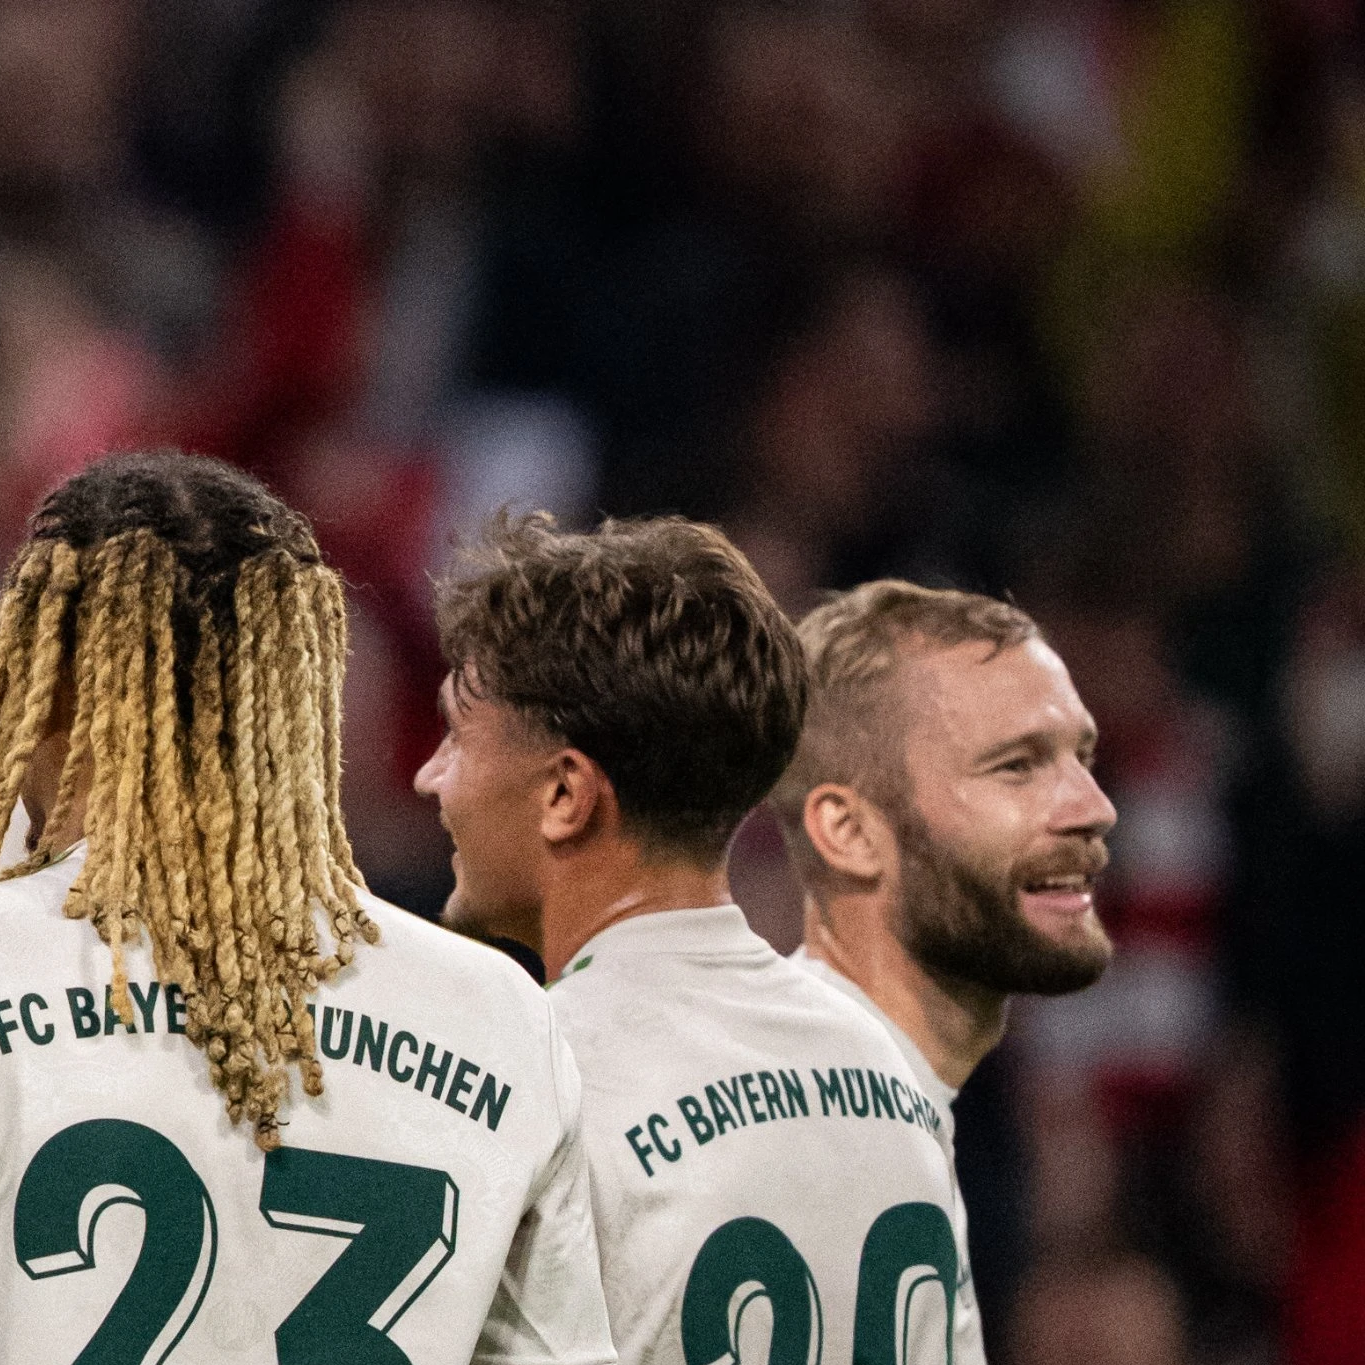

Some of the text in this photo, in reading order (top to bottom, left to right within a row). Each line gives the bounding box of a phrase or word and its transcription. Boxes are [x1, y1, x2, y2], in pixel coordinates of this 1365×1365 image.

[65, 982, 187, 1039] BAYE
[309, 1002, 512, 1131] ÜNCHEN
[625, 1113, 682, 1177] FC
[677, 1069, 810, 1146] BAYERN
